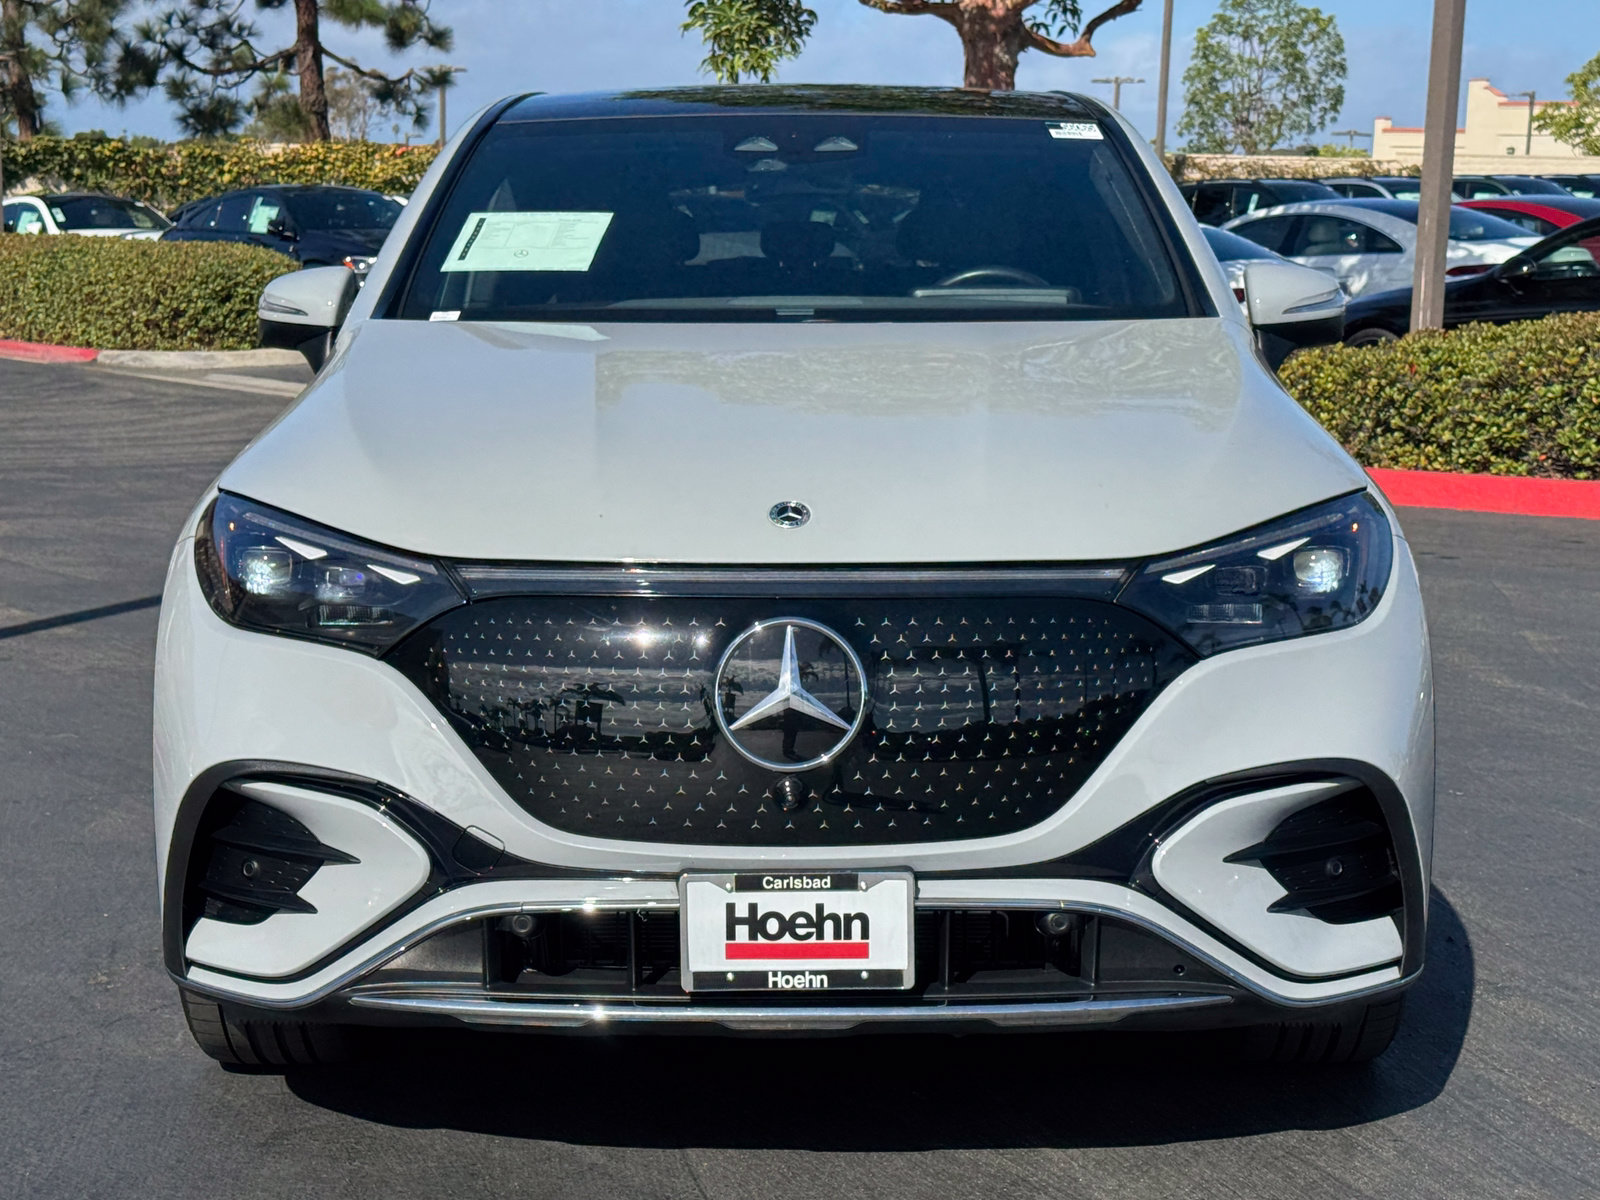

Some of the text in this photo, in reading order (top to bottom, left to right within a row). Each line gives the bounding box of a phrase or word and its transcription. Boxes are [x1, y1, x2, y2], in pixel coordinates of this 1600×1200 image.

[762, 876, 831, 889] Carlsbad
[725, 902, 870, 941] Hoehn
[768, 971, 828, 988] Hoehn
